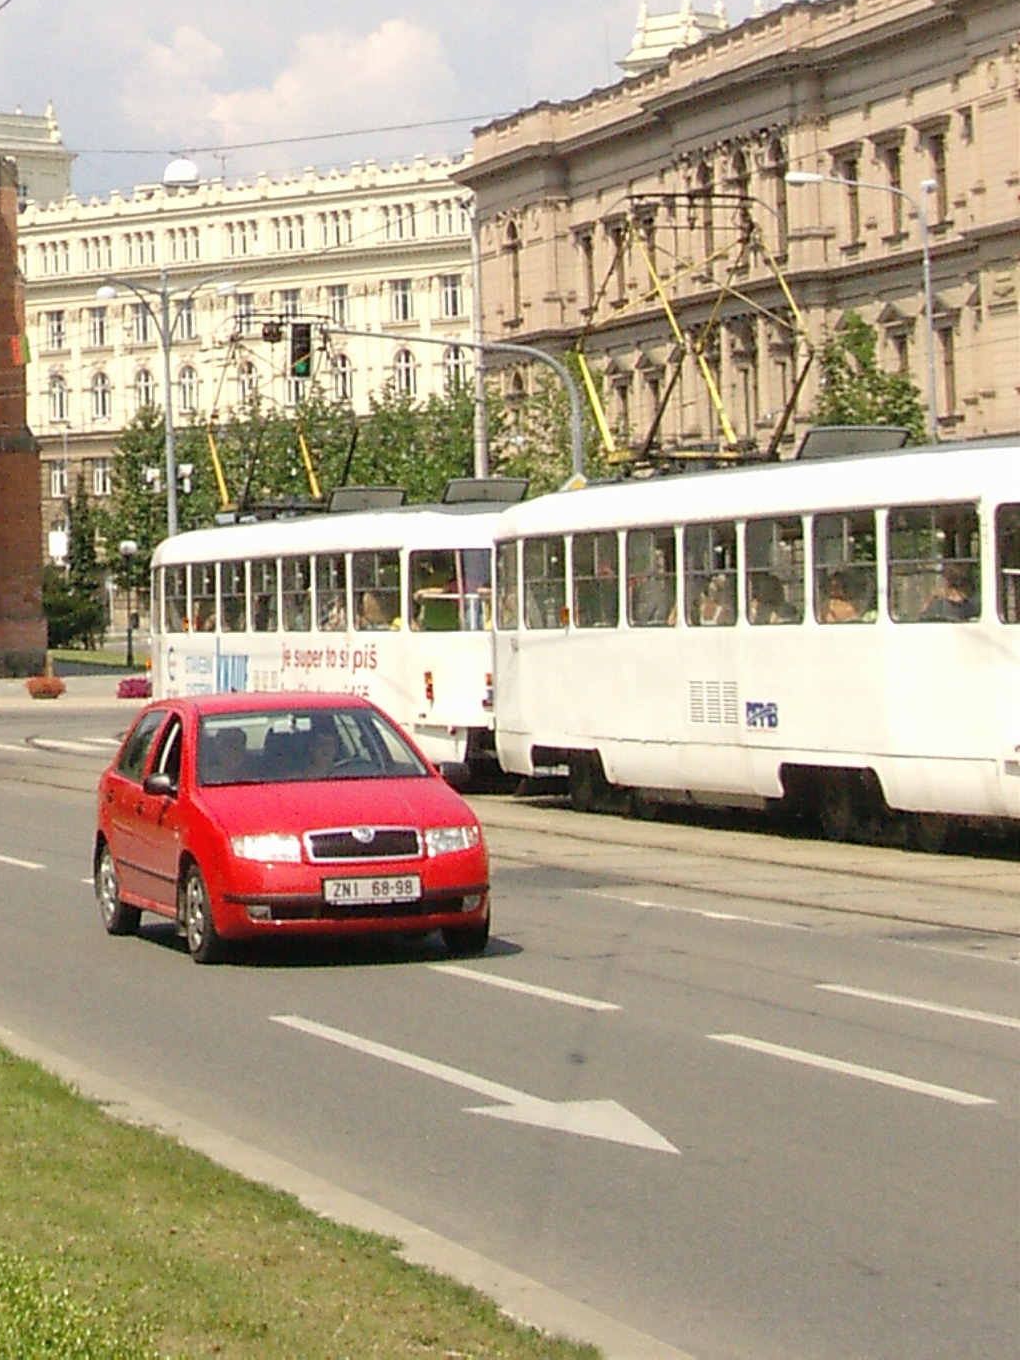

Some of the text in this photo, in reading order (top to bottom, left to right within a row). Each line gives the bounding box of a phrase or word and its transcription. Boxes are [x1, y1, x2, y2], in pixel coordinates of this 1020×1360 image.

[281, 643, 378, 674] je super to si piš
[372, 880, 413, 896] 68-98
